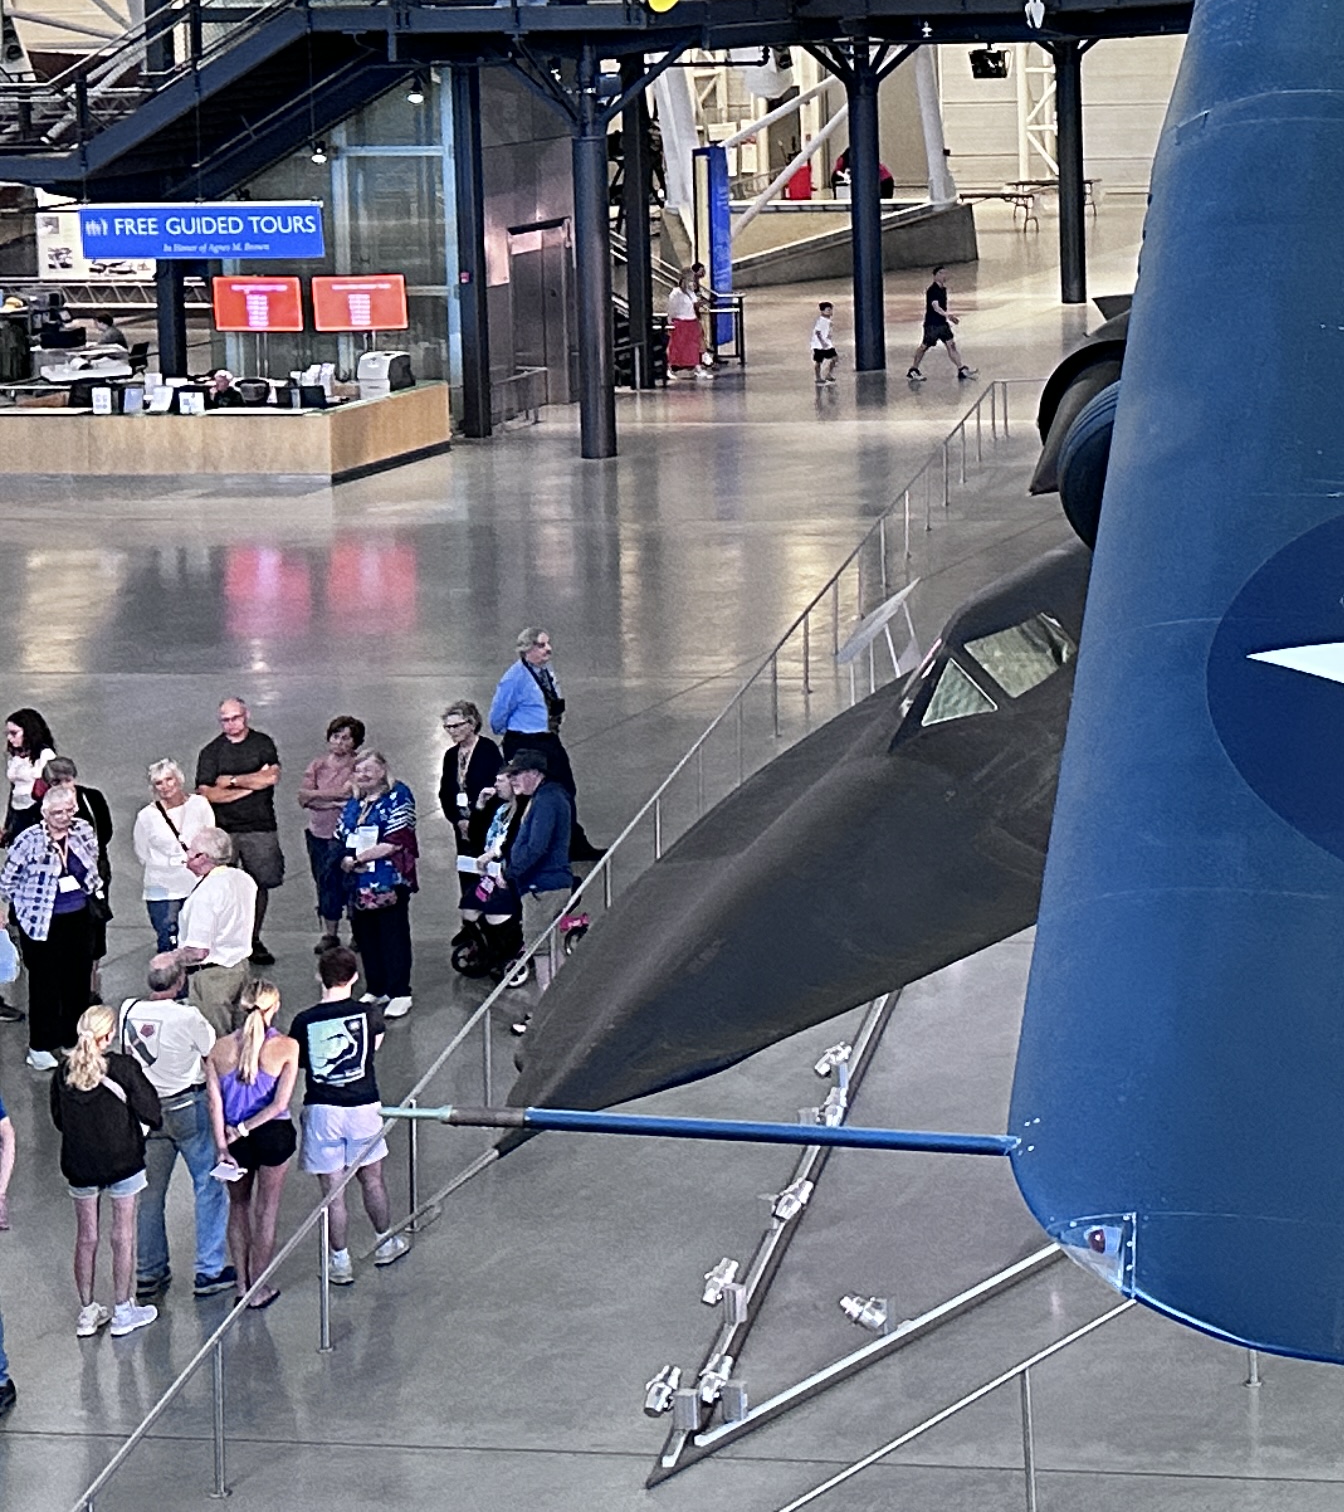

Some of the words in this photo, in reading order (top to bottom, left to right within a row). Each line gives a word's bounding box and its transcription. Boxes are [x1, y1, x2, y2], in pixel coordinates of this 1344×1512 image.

[114, 218, 159, 236] FREE
[165, 216, 244, 235] GUIDED
[248, 215, 317, 234] TOURS
